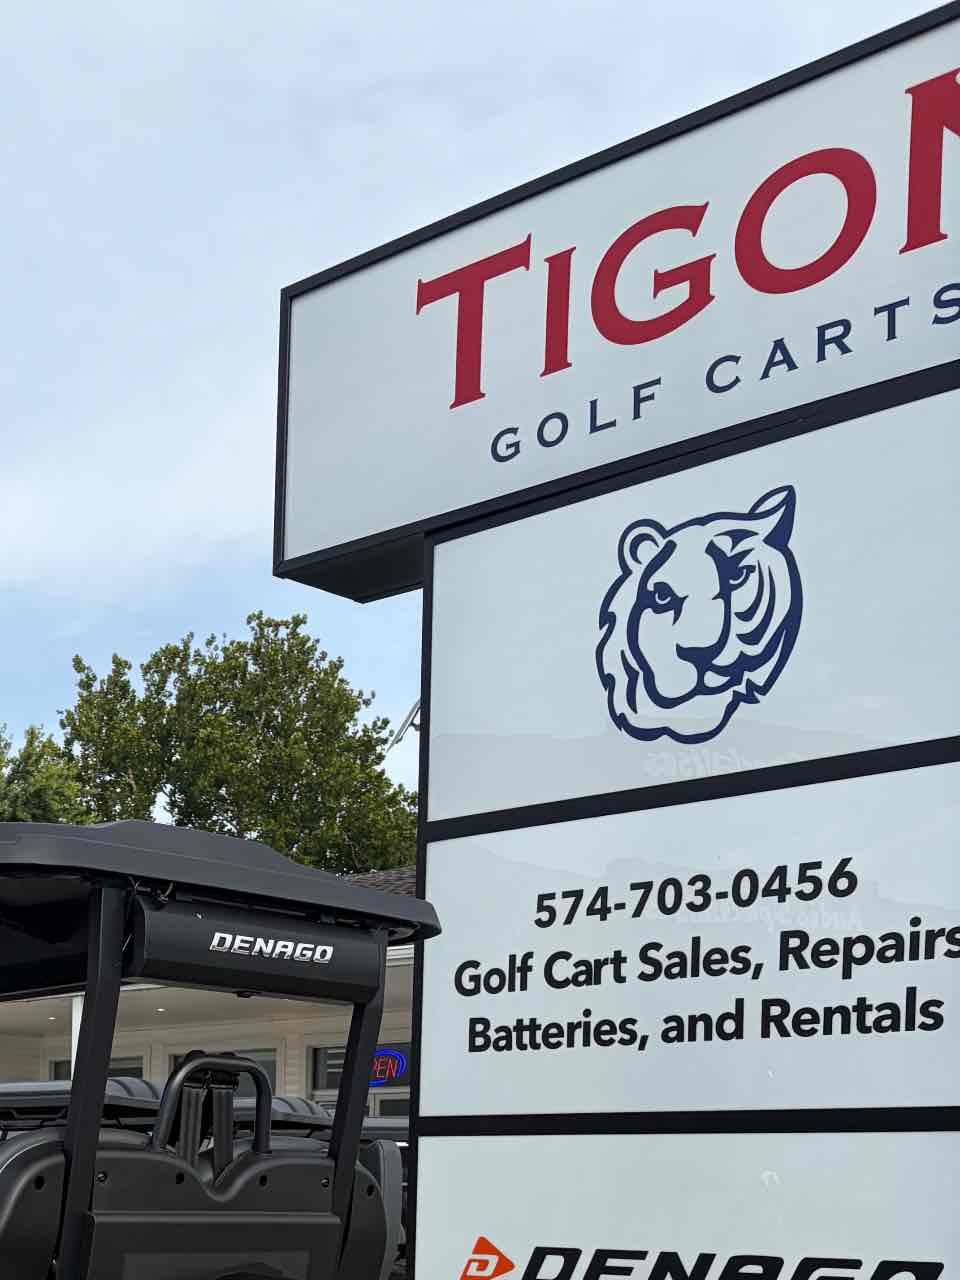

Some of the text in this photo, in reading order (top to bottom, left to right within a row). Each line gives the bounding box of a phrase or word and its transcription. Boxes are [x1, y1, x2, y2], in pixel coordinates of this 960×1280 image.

[490, 282, 960, 463] GOLF CARTS
[534, 857, 858, 929] 574-703-0456
[209, 931, 334, 964] DENAGO
[454, 953, 533, 997] Golf
[543, 949, 628, 990] Cart
[637, 935, 764, 982] Sales,
[778, 916, 960, 980] Repairs
[468, 986, 945, 1053] Batteries, and Rentals
